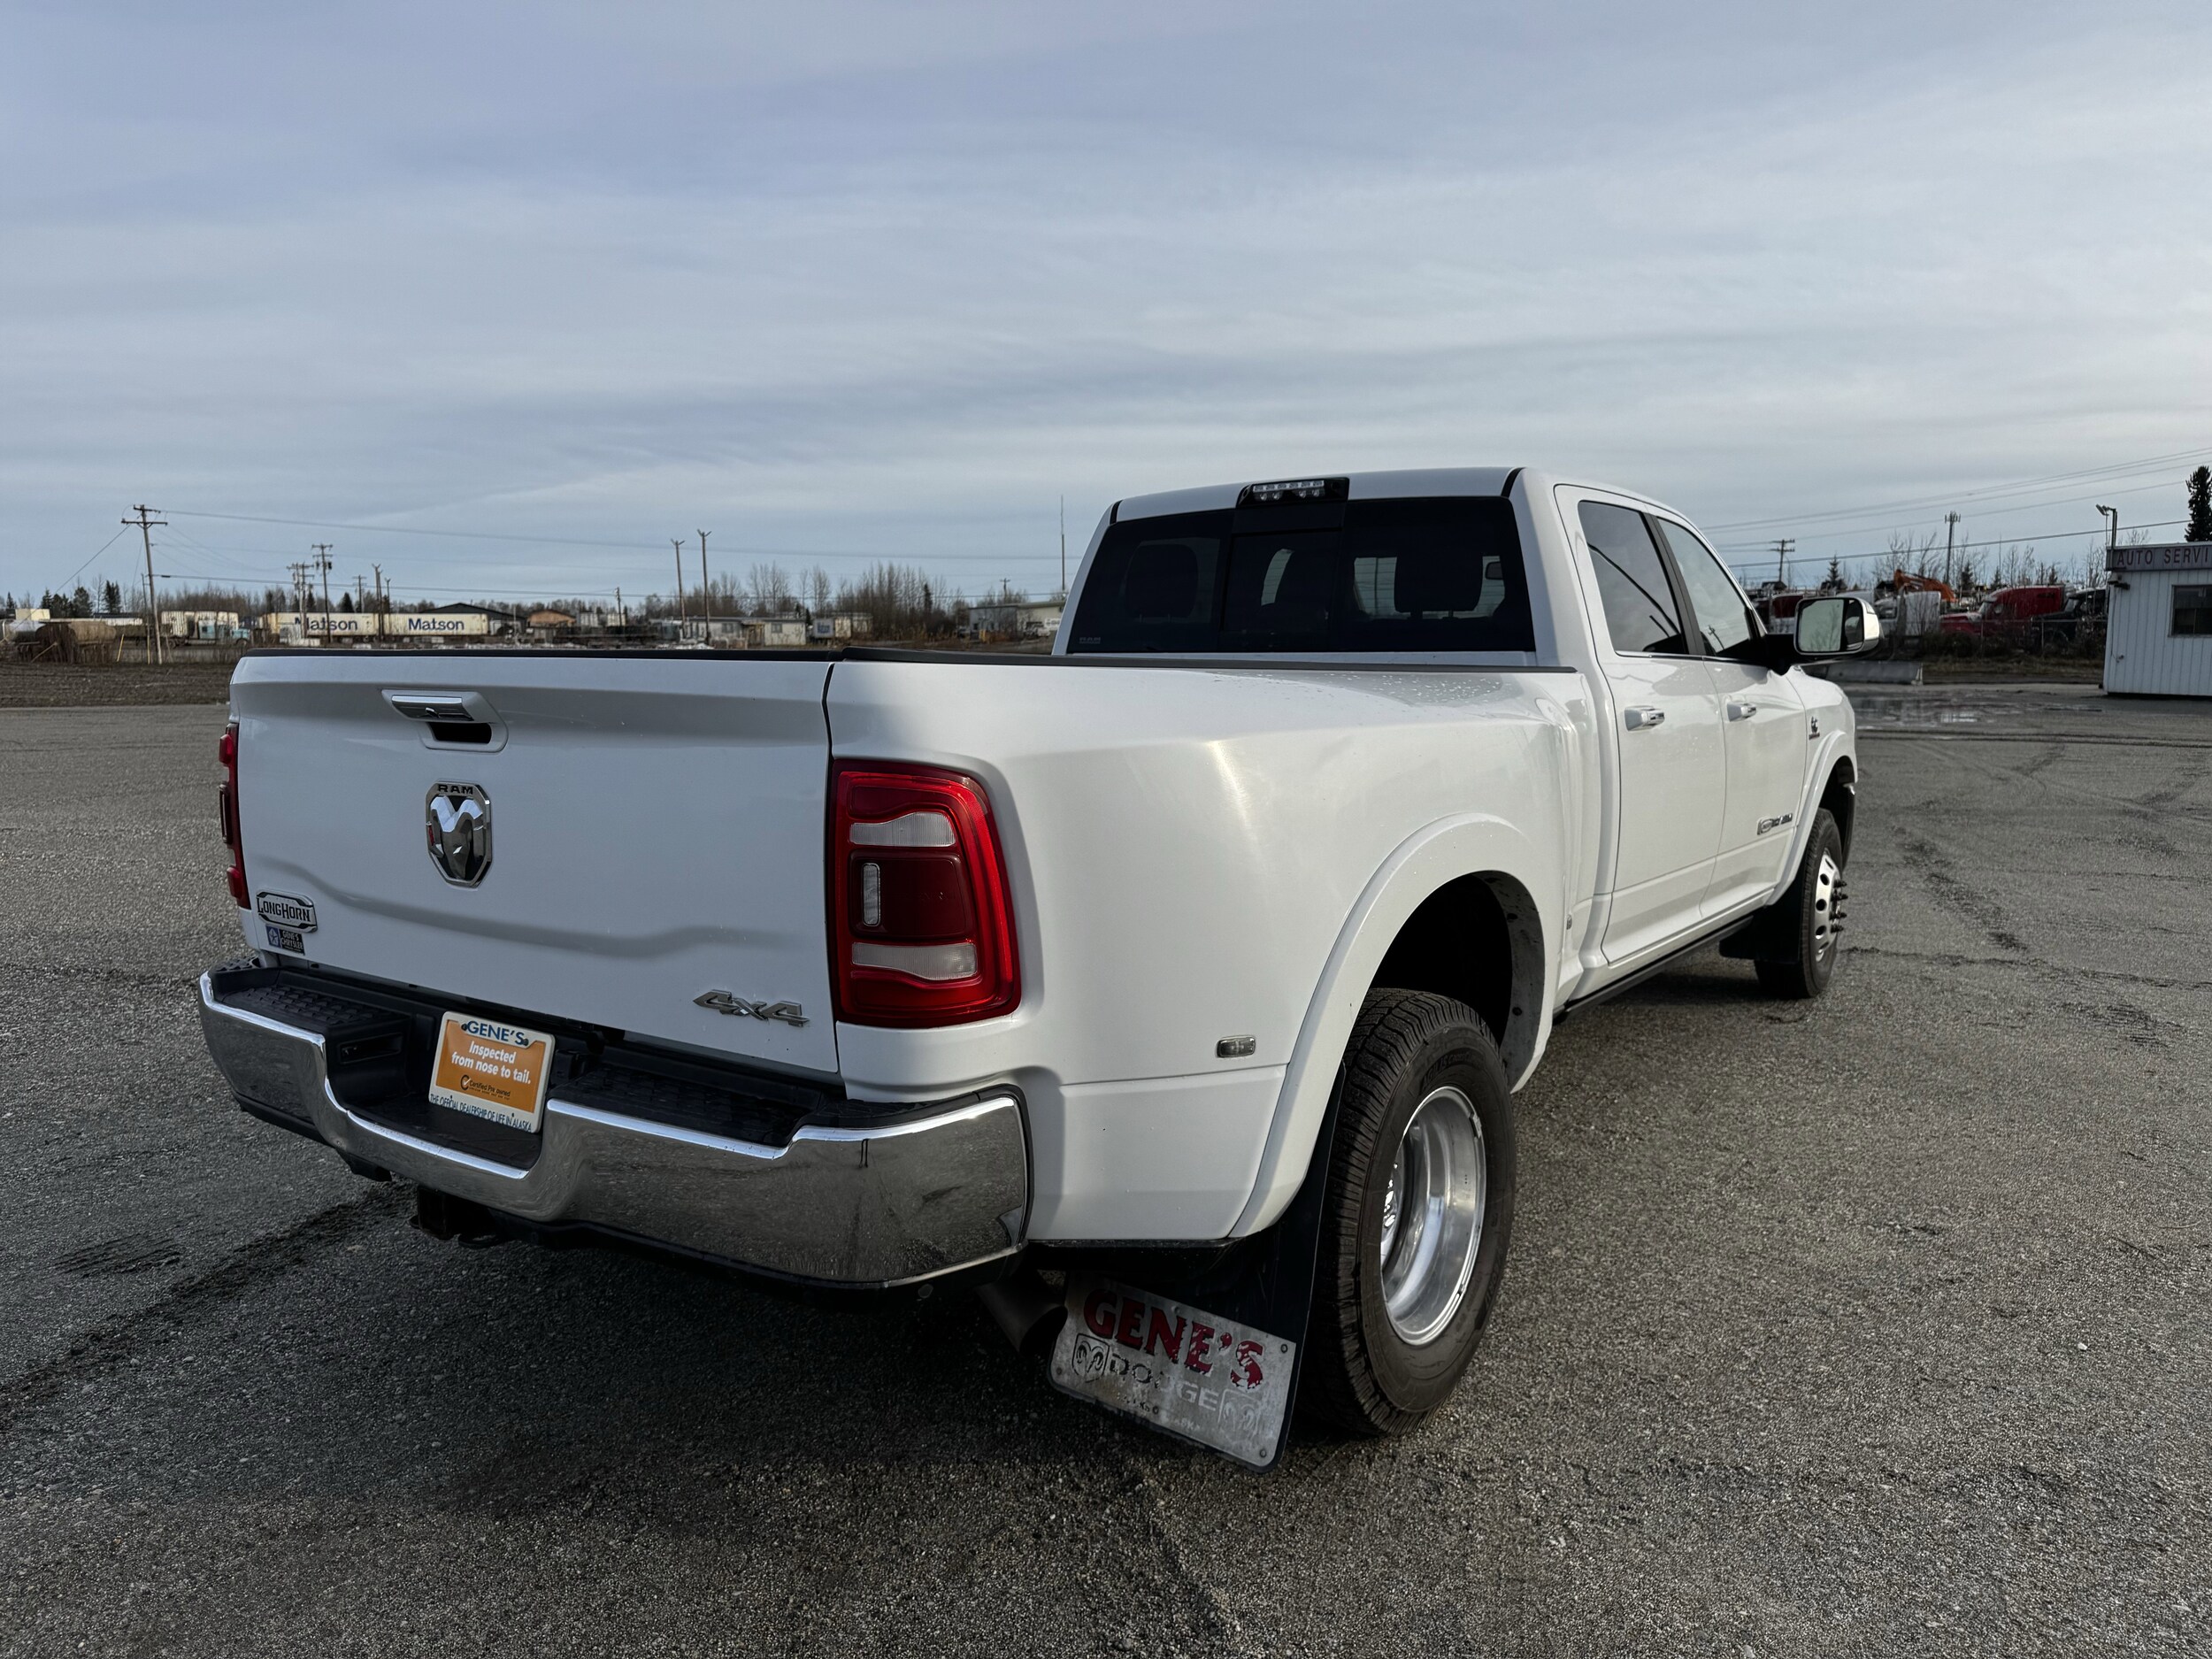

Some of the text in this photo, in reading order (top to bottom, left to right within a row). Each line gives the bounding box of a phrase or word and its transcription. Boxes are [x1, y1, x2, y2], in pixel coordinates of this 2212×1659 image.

[2117, 548, 2208, 566] AUTO SERVI
[408, 618, 465, 631] Matson
[437, 784, 473, 795] RAM
[466, 1020, 525, 1046] GENE'S
[469, 1041, 517, 1064] Inspected
[451, 1051, 532, 1085] from nose to tail.
[469, 1079, 488, 1090] Certified
[430, 1094, 440, 1103] THE
[513, 1118, 532, 1133] ALASKA
[1083, 1289, 1263, 1390] GENE'S
[1110, 1353, 1219, 1412] DOGE
